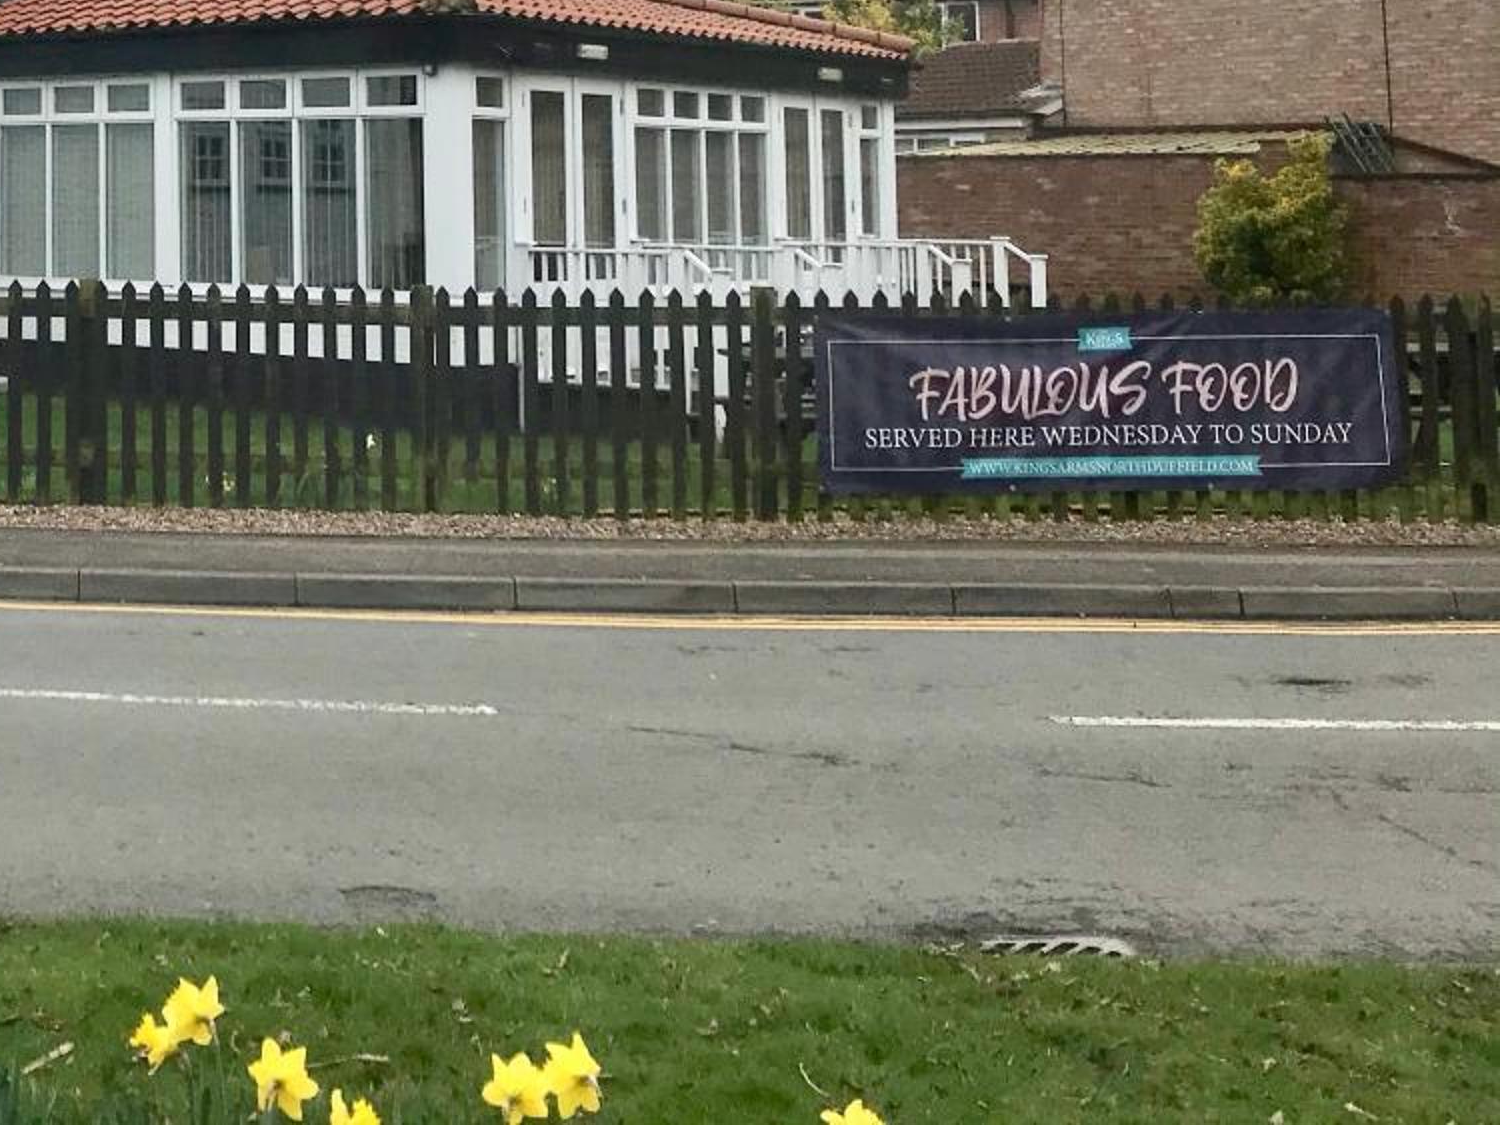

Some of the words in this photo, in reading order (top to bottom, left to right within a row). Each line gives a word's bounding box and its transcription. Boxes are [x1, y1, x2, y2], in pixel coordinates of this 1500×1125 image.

[909, 359, 1152, 422] FABULOUS
[1162, 357, 1299, 414] FOOD
[865, 427, 962, 449] SERVED
[970, 426, 1036, 448] HERE
[1040, 424, 1203, 447] WEDNESDAY
[1209, 423, 1244, 445] TO
[1250, 422, 1353, 445] SUNDAY
